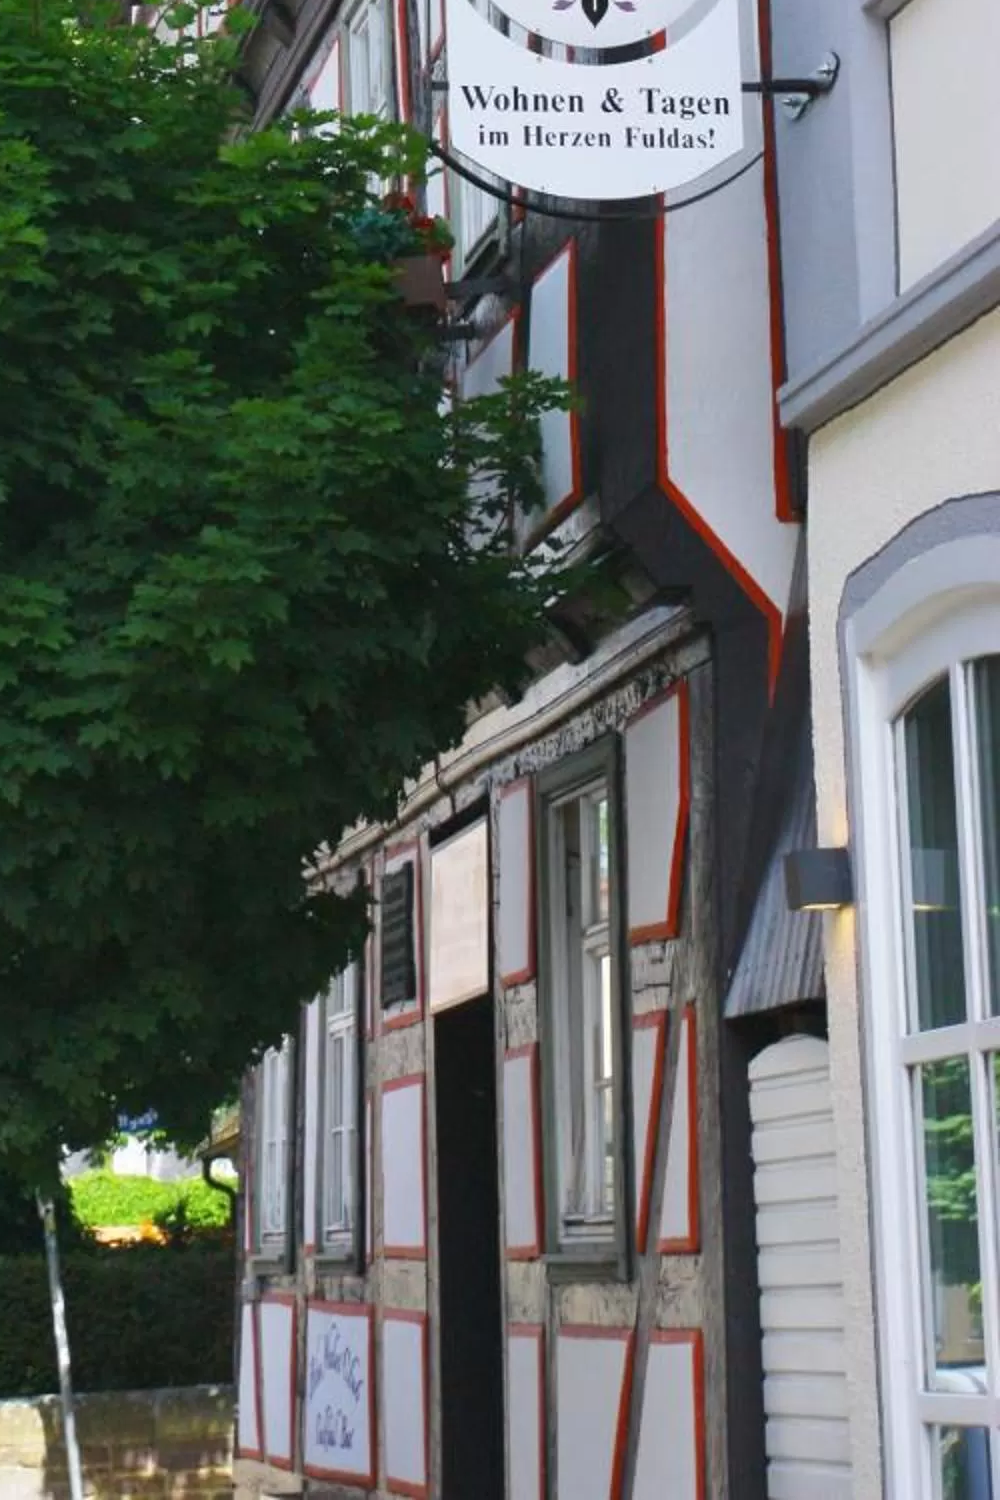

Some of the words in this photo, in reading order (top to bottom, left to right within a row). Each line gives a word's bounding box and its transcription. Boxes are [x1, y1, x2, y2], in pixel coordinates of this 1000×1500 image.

[461, 85, 584, 113] Wohnen
[600, 87, 624, 113] &
[639, 87, 730, 119] Tagen
[478, 124, 509, 146] im
[523, 125, 612, 147] Herzen
[625, 127, 716, 149] Fuldas!
